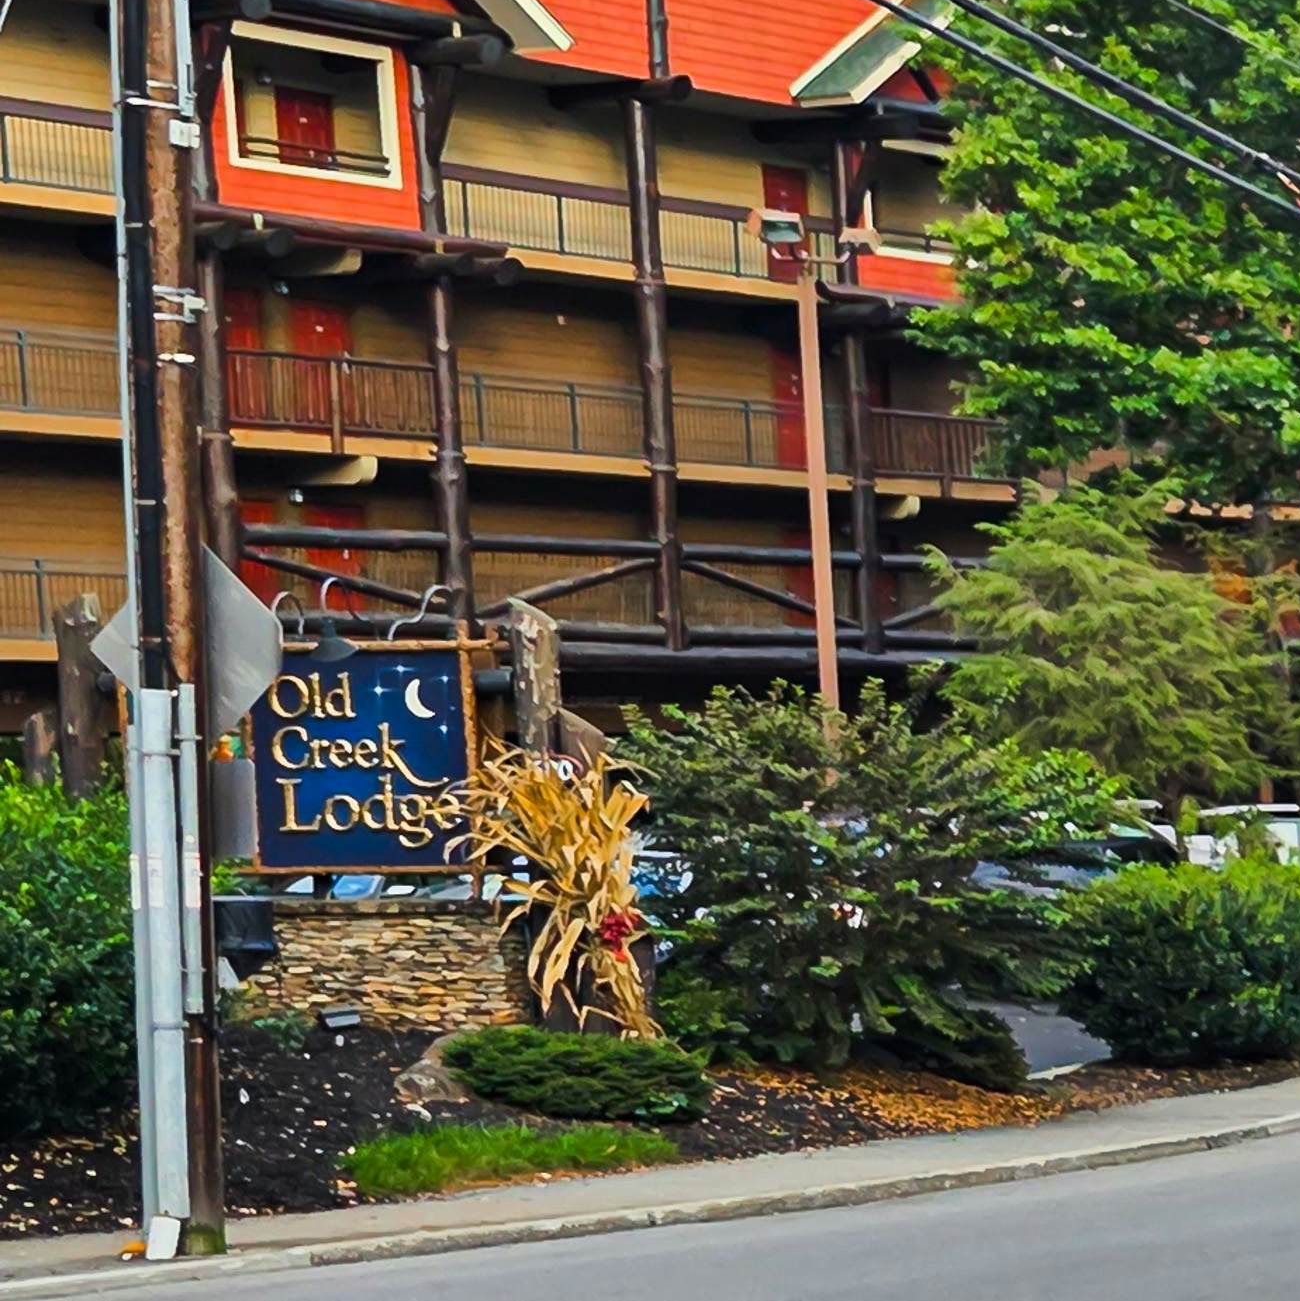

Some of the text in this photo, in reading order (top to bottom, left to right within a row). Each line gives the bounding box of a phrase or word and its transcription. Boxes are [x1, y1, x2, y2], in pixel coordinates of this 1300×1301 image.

[268, 671, 357, 719] Old
[272, 721, 450, 788] Creek
[275, 773, 464, 848] Lodge
